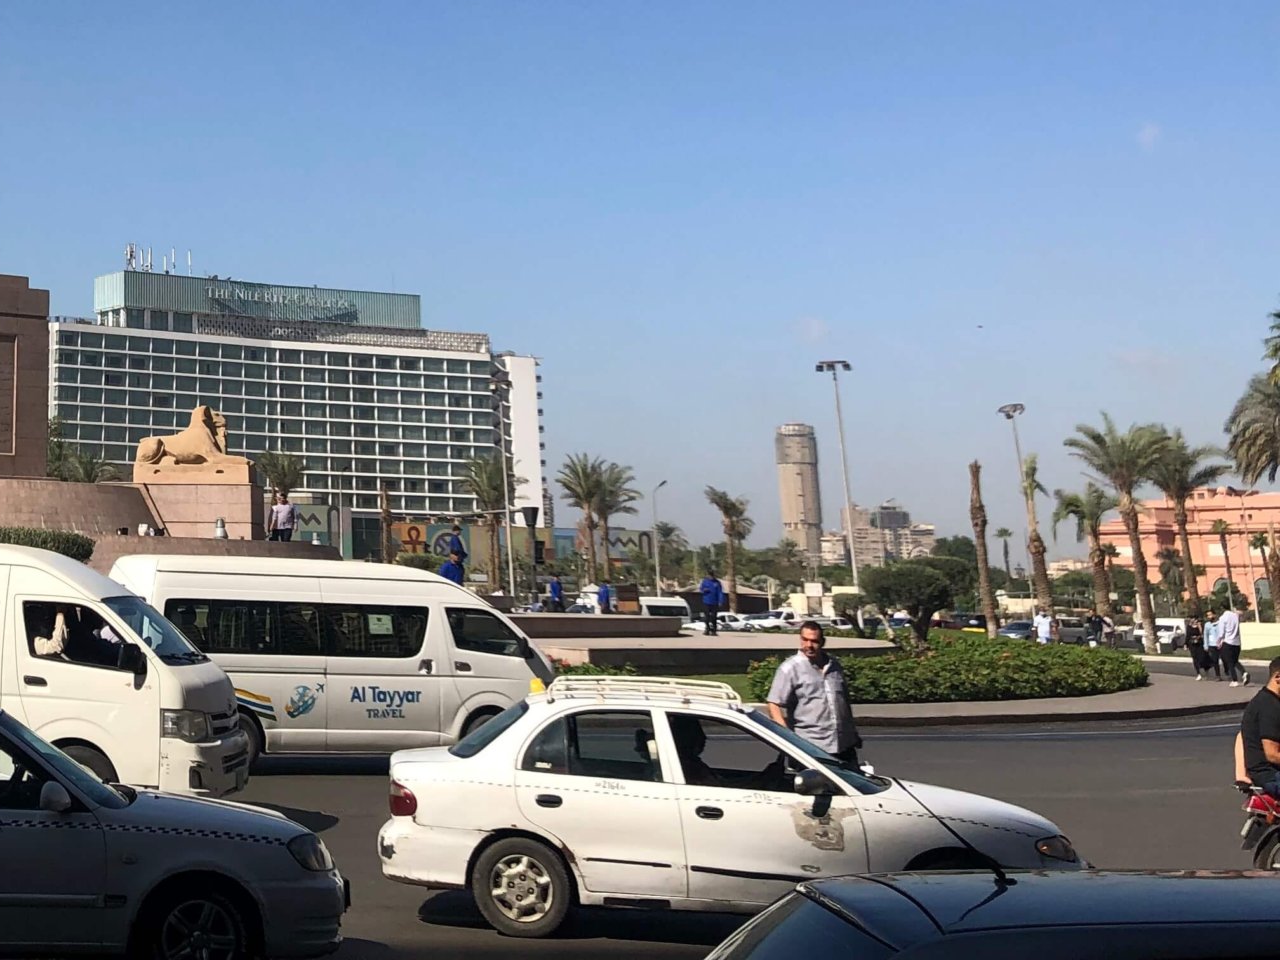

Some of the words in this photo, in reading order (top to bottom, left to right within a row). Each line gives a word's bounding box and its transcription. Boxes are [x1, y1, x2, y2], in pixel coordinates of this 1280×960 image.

[205, 286, 231, 299] THE
[235, 288, 261, 301] NILE
[350, 686, 366, 702] Al
[368, 686, 422, 707] Tayyar
[366, 709, 405, 718] TRAVEL
